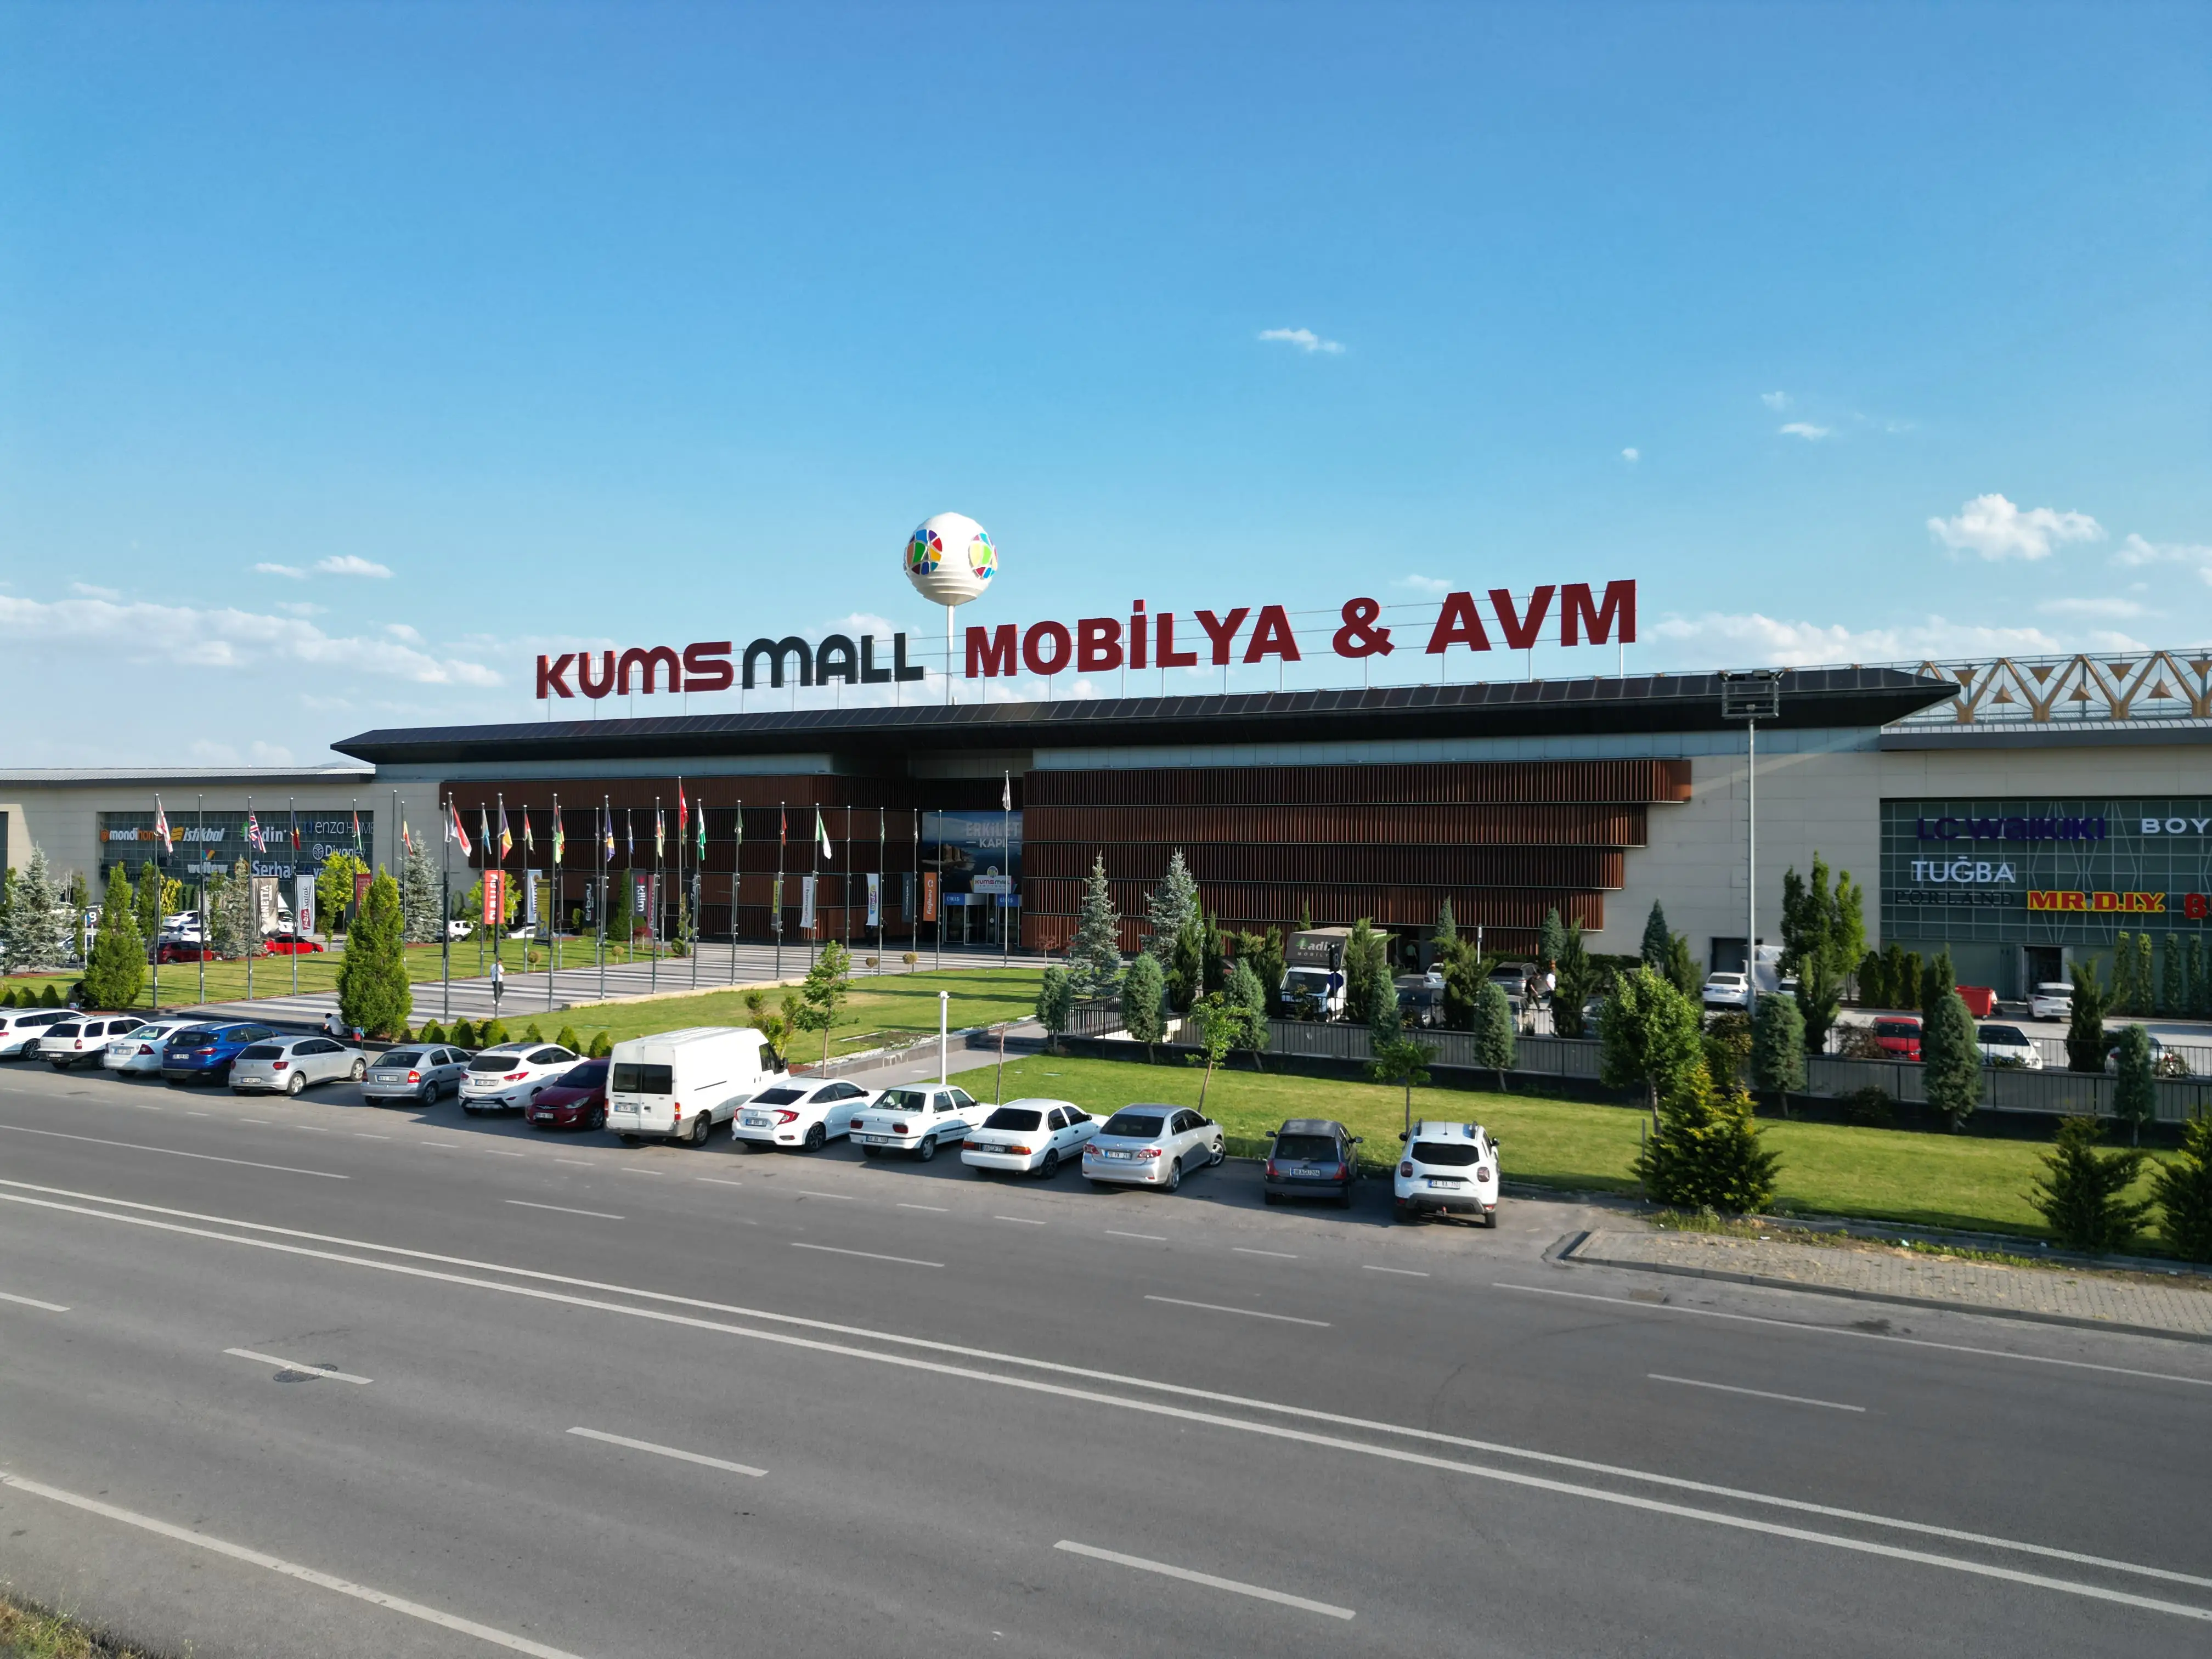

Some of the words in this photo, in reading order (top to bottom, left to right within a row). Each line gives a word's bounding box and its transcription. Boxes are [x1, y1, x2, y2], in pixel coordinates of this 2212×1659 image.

[965, 599, 1302, 678] MOBİLYA
[1332, 597, 1395, 658] &
[1425, 579, 1637, 654] AVM
[315, 821, 345, 834] enza
[2142, 818, 2211, 834] BOY
[252, 860, 297, 879] Serha
[1911, 856, 2016, 883] TUĞBA
[1895, 890, 2015, 906] PORLAND
[1300, 940, 1330, 951] Ladi
